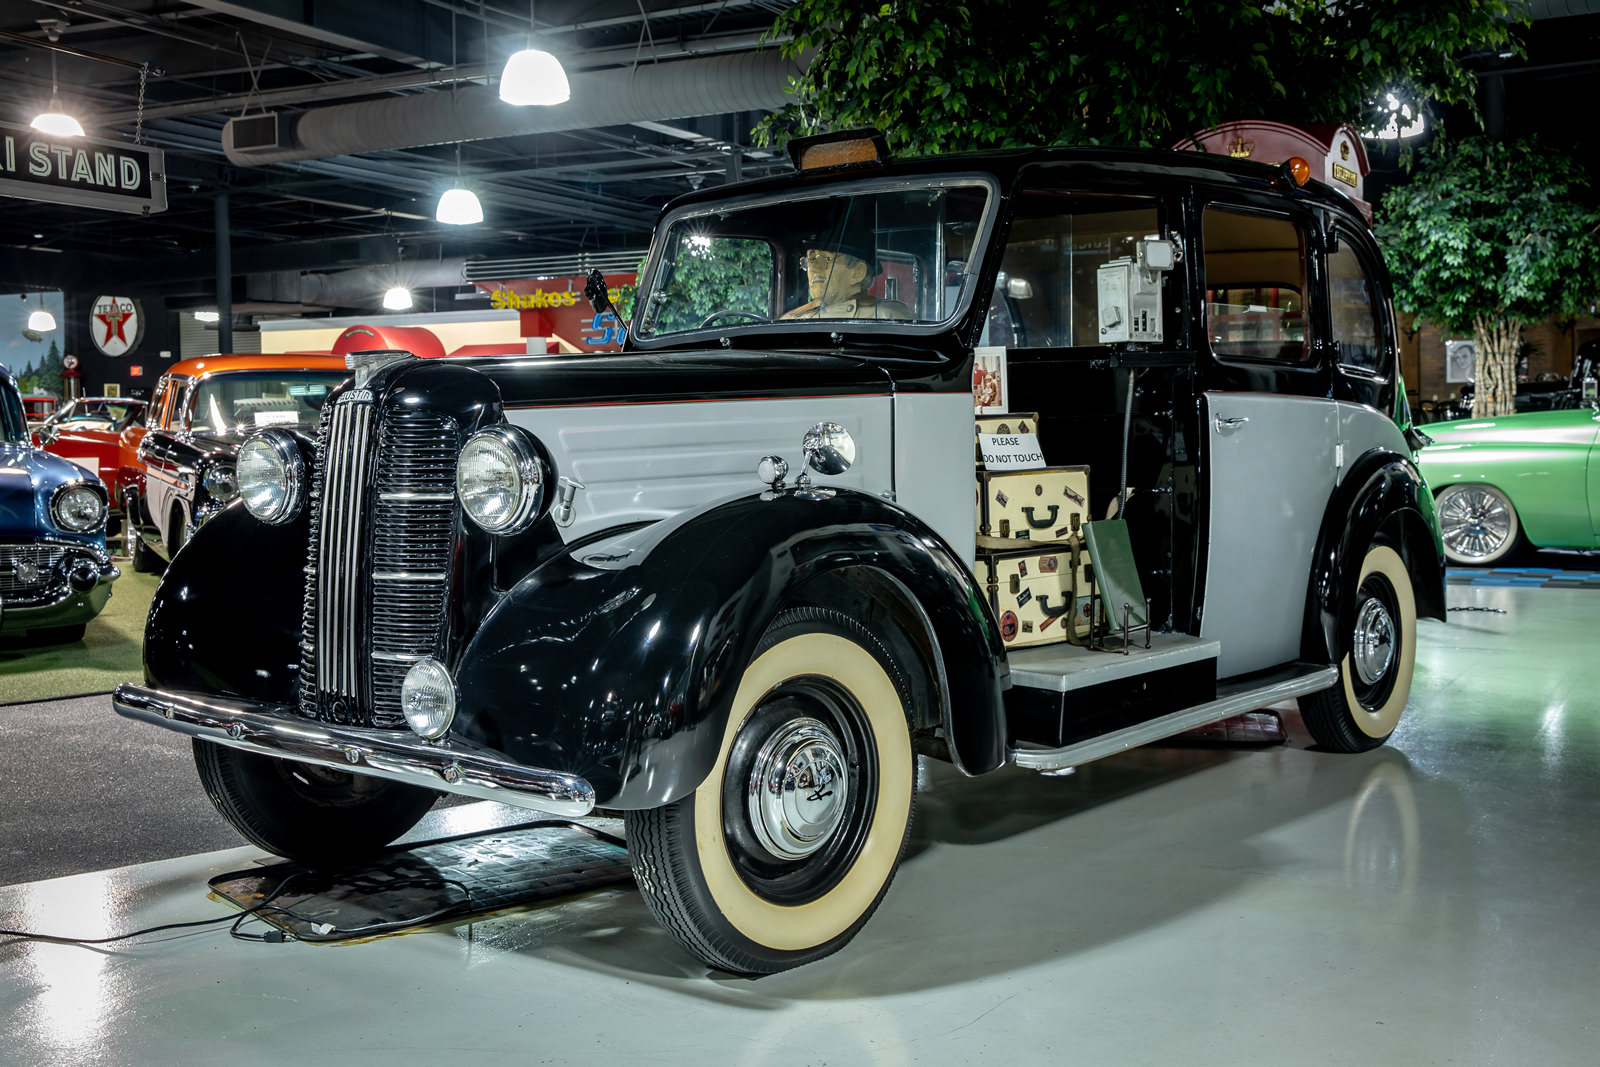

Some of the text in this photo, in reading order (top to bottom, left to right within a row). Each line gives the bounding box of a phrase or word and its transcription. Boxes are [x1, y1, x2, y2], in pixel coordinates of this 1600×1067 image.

[0, 136, 141, 191] I STAND
[490, 288, 577, 309] Shakes
[97, 303, 133, 314] TEXACO
[339, 390, 370, 401] AUSTIN
[991, 437, 1020, 446] PLEASE
[983, 453, 1044, 463] DO NOT TOUCH
